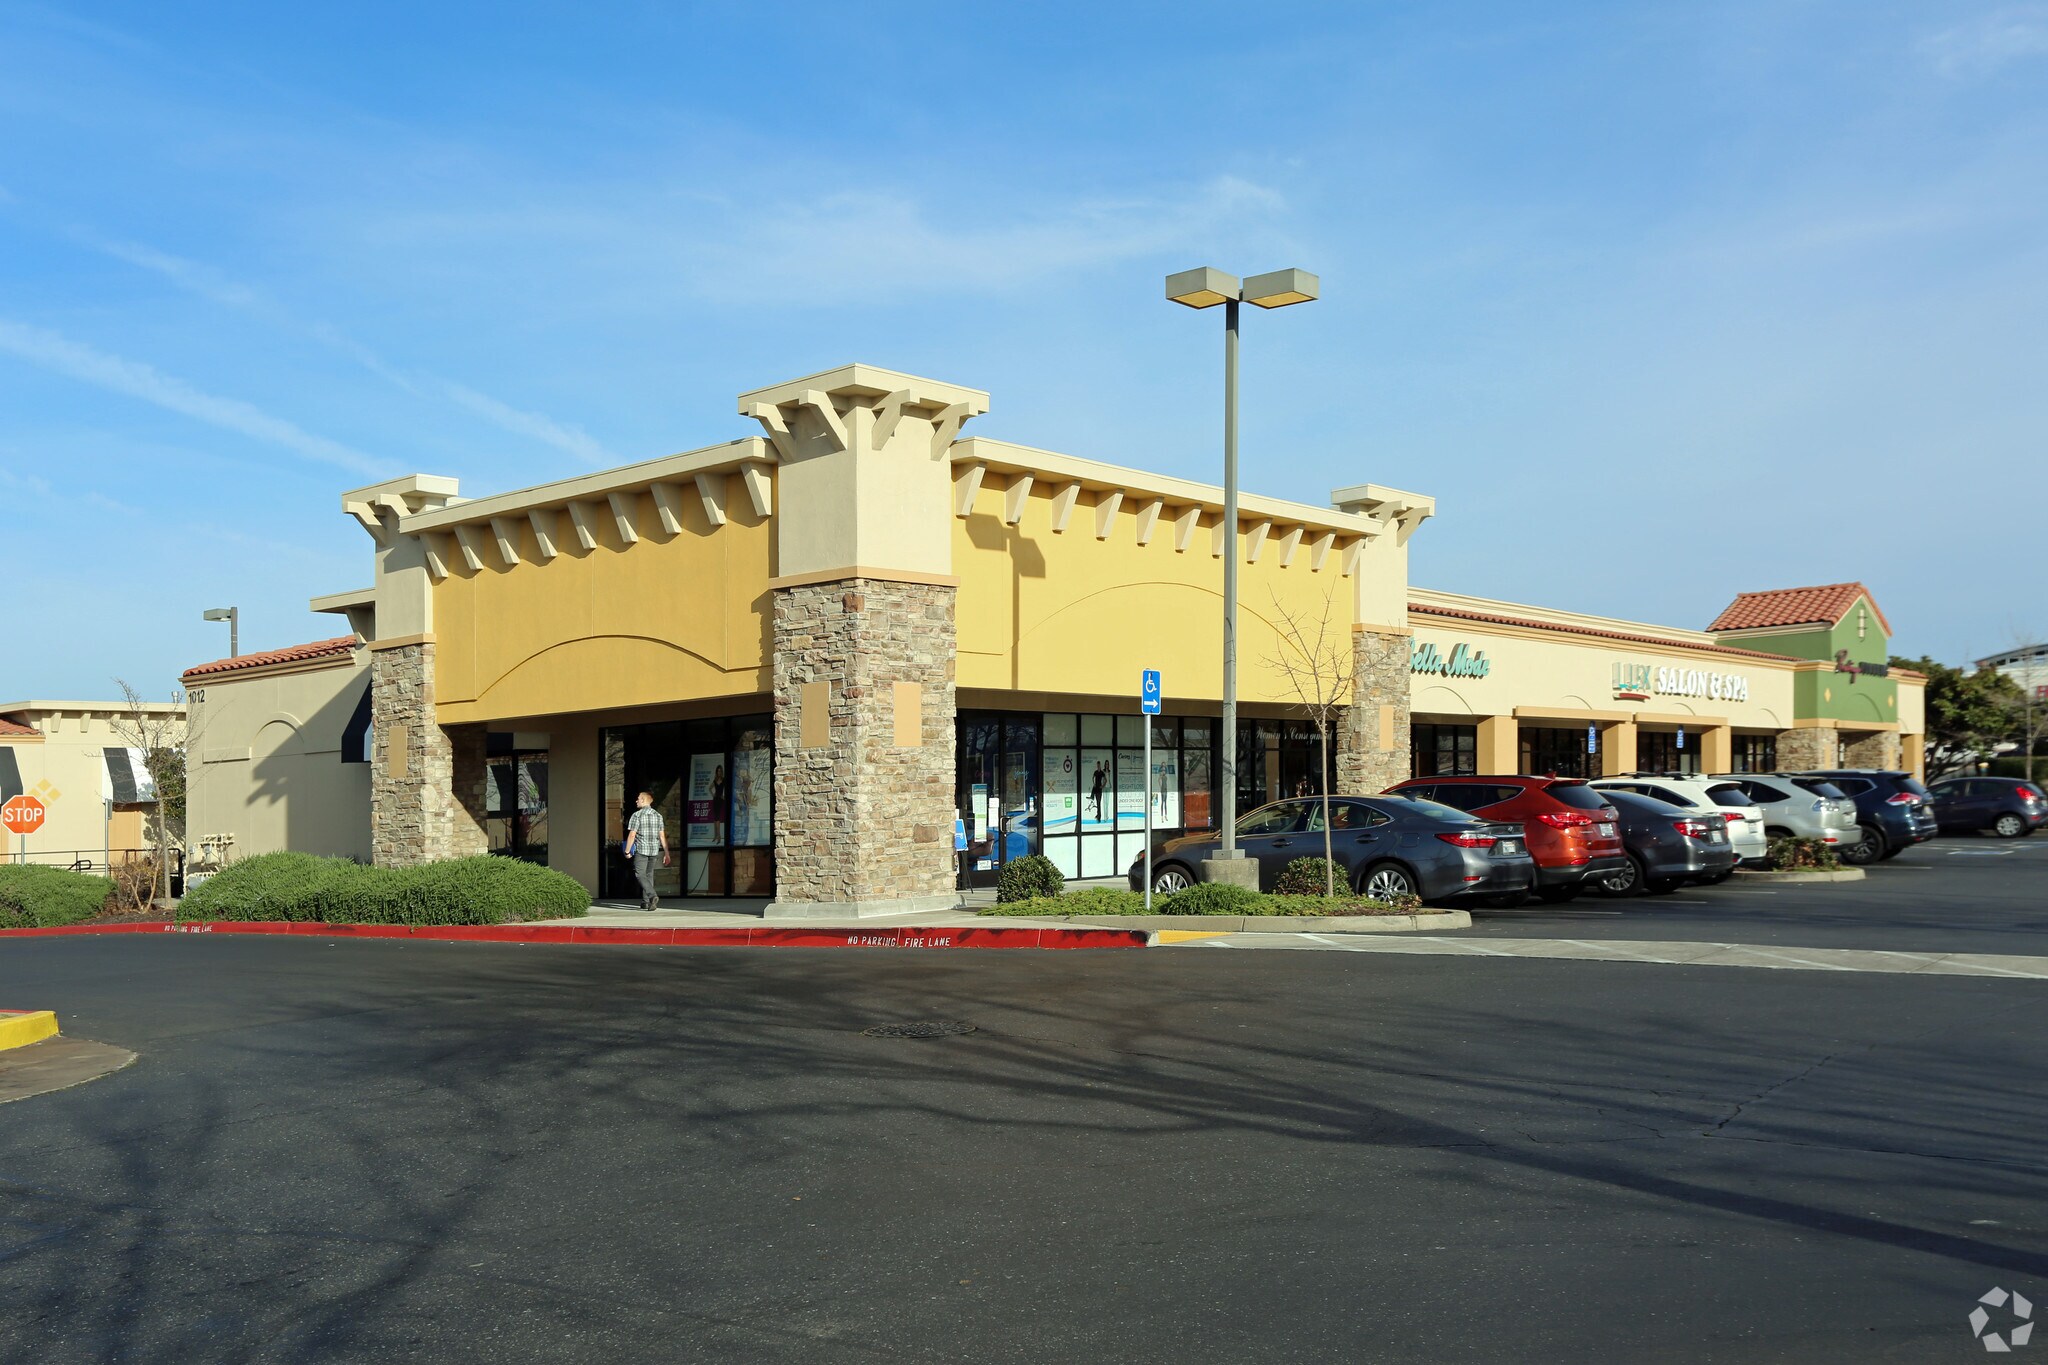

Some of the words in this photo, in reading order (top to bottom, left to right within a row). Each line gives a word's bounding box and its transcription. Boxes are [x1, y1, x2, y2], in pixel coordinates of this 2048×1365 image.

[1612, 662, 1651, 691] LUX
[1655, 667, 1708, 696] SALON
[1708, 672, 1721, 699] &
[1722, 675, 1748, 701] SPA
[188, 689, 205, 704] 1012
[5, 808, 43, 822] STOP
[847, 936, 858, 945] NO
[861, 936, 896, 947] PARKING
[904, 938, 924, 948] FIRE
[928, 937, 951, 946] LANE
